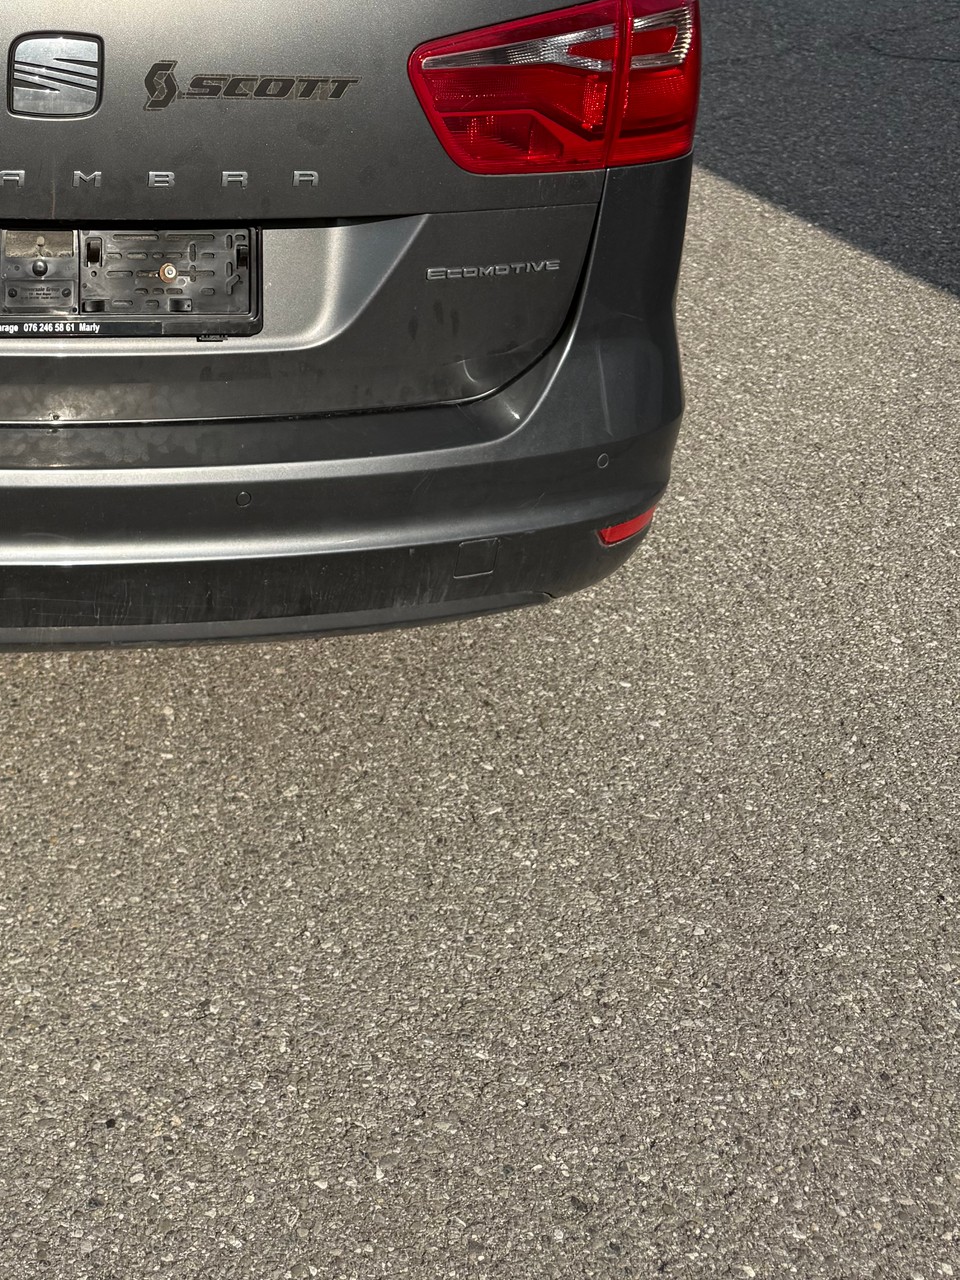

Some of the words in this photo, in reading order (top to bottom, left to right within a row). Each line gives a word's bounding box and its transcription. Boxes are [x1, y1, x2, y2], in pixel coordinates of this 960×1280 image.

[183, 74, 362, 100] SCOTT
[23, 323, 38, 332] 076
[39, 323, 53, 332] 246
[54, 323, 64, 332] 58
[65, 323, 75, 332] 61
[79, 322, 100, 333] Marly
